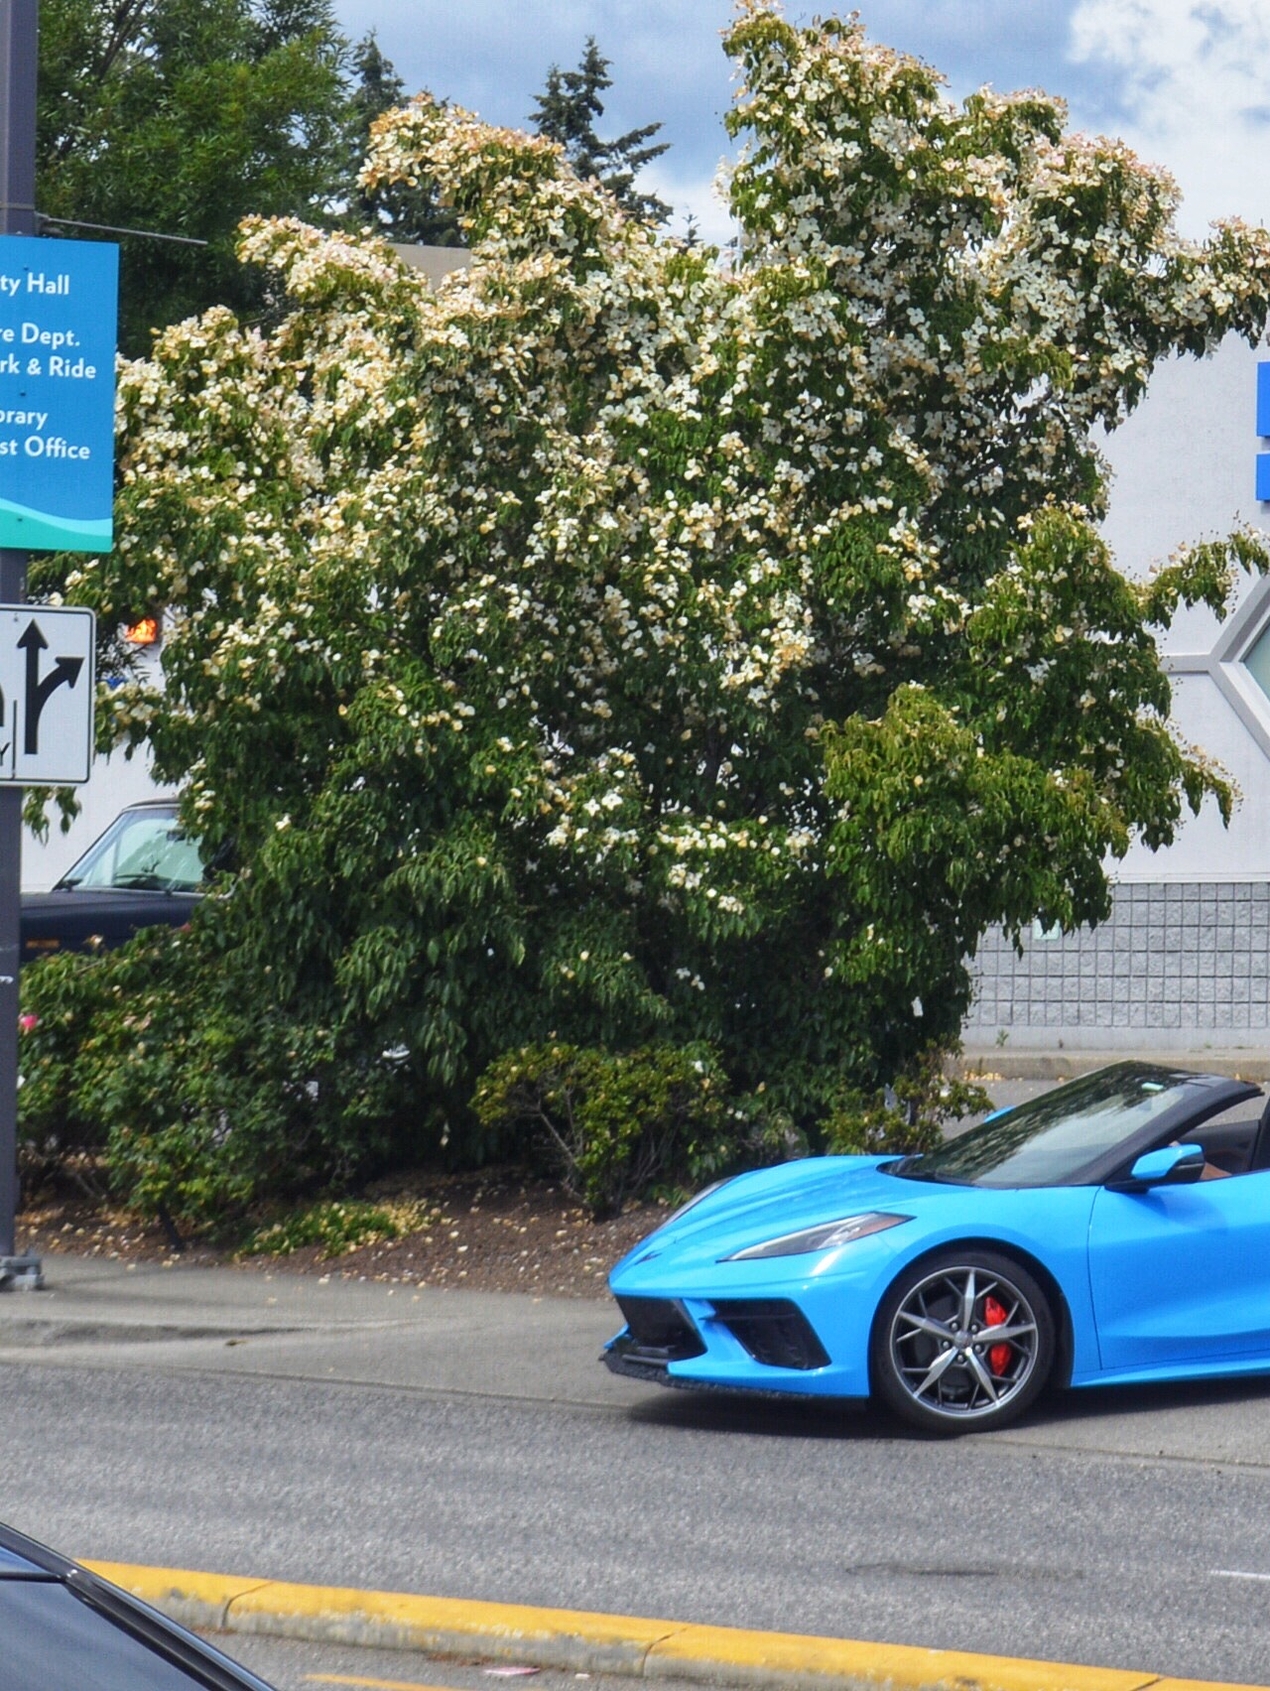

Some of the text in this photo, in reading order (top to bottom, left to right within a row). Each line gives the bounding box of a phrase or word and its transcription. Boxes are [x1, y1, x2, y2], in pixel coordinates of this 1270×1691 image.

[27, 272, 70, 295] Hall
[21, 322, 80, 350] Dept.
[27, 358, 42, 375] &
[49, 355, 96, 379] Ride
[24, 435, 91, 459] Office
